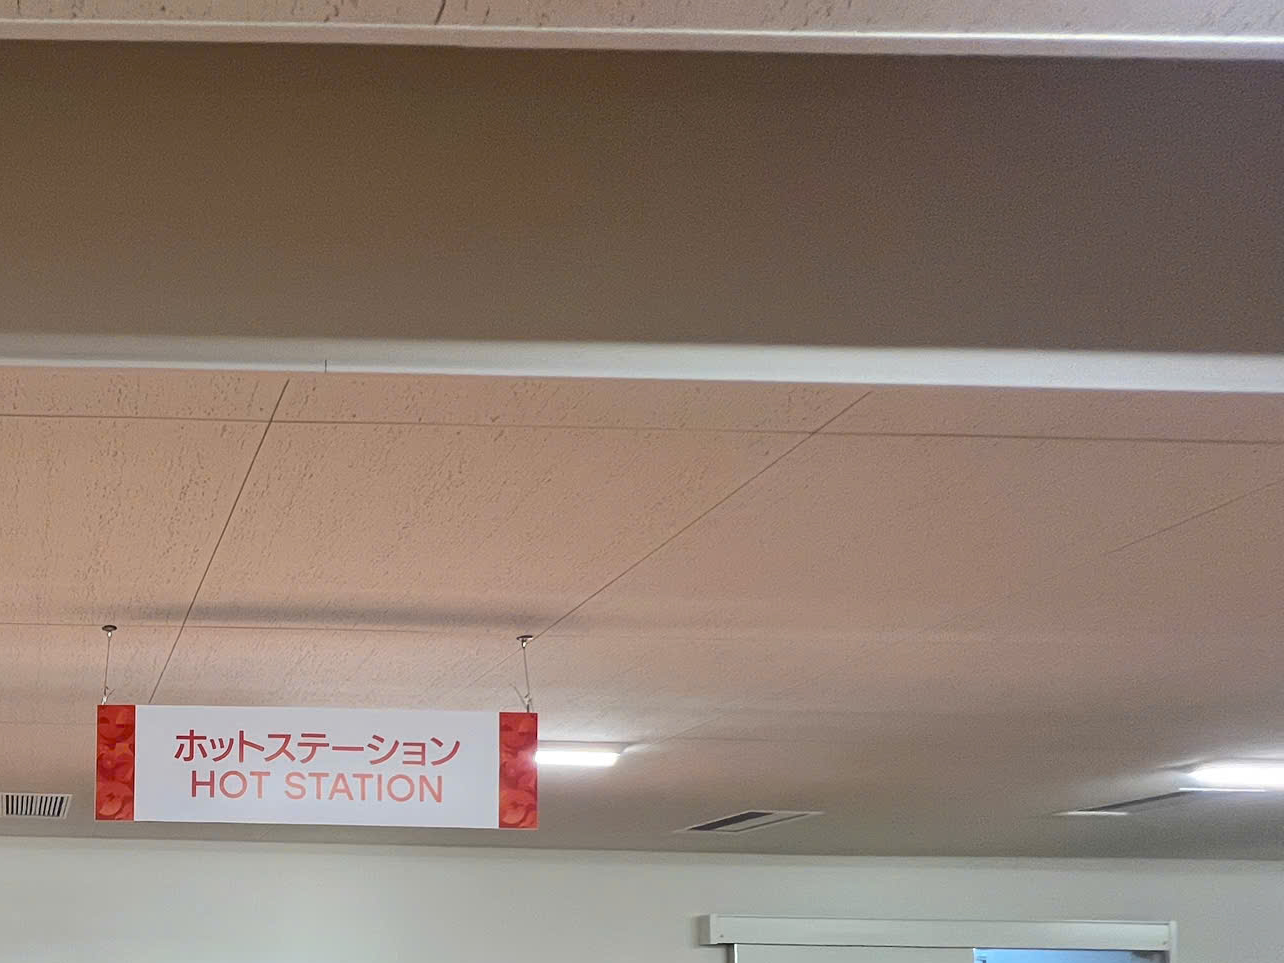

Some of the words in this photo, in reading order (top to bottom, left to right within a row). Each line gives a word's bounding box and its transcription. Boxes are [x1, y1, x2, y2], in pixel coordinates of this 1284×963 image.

[173, 728, 462, 767] ホットステーション
[190, 769, 272, 800] HOT
[283, 770, 444, 804] STATION
